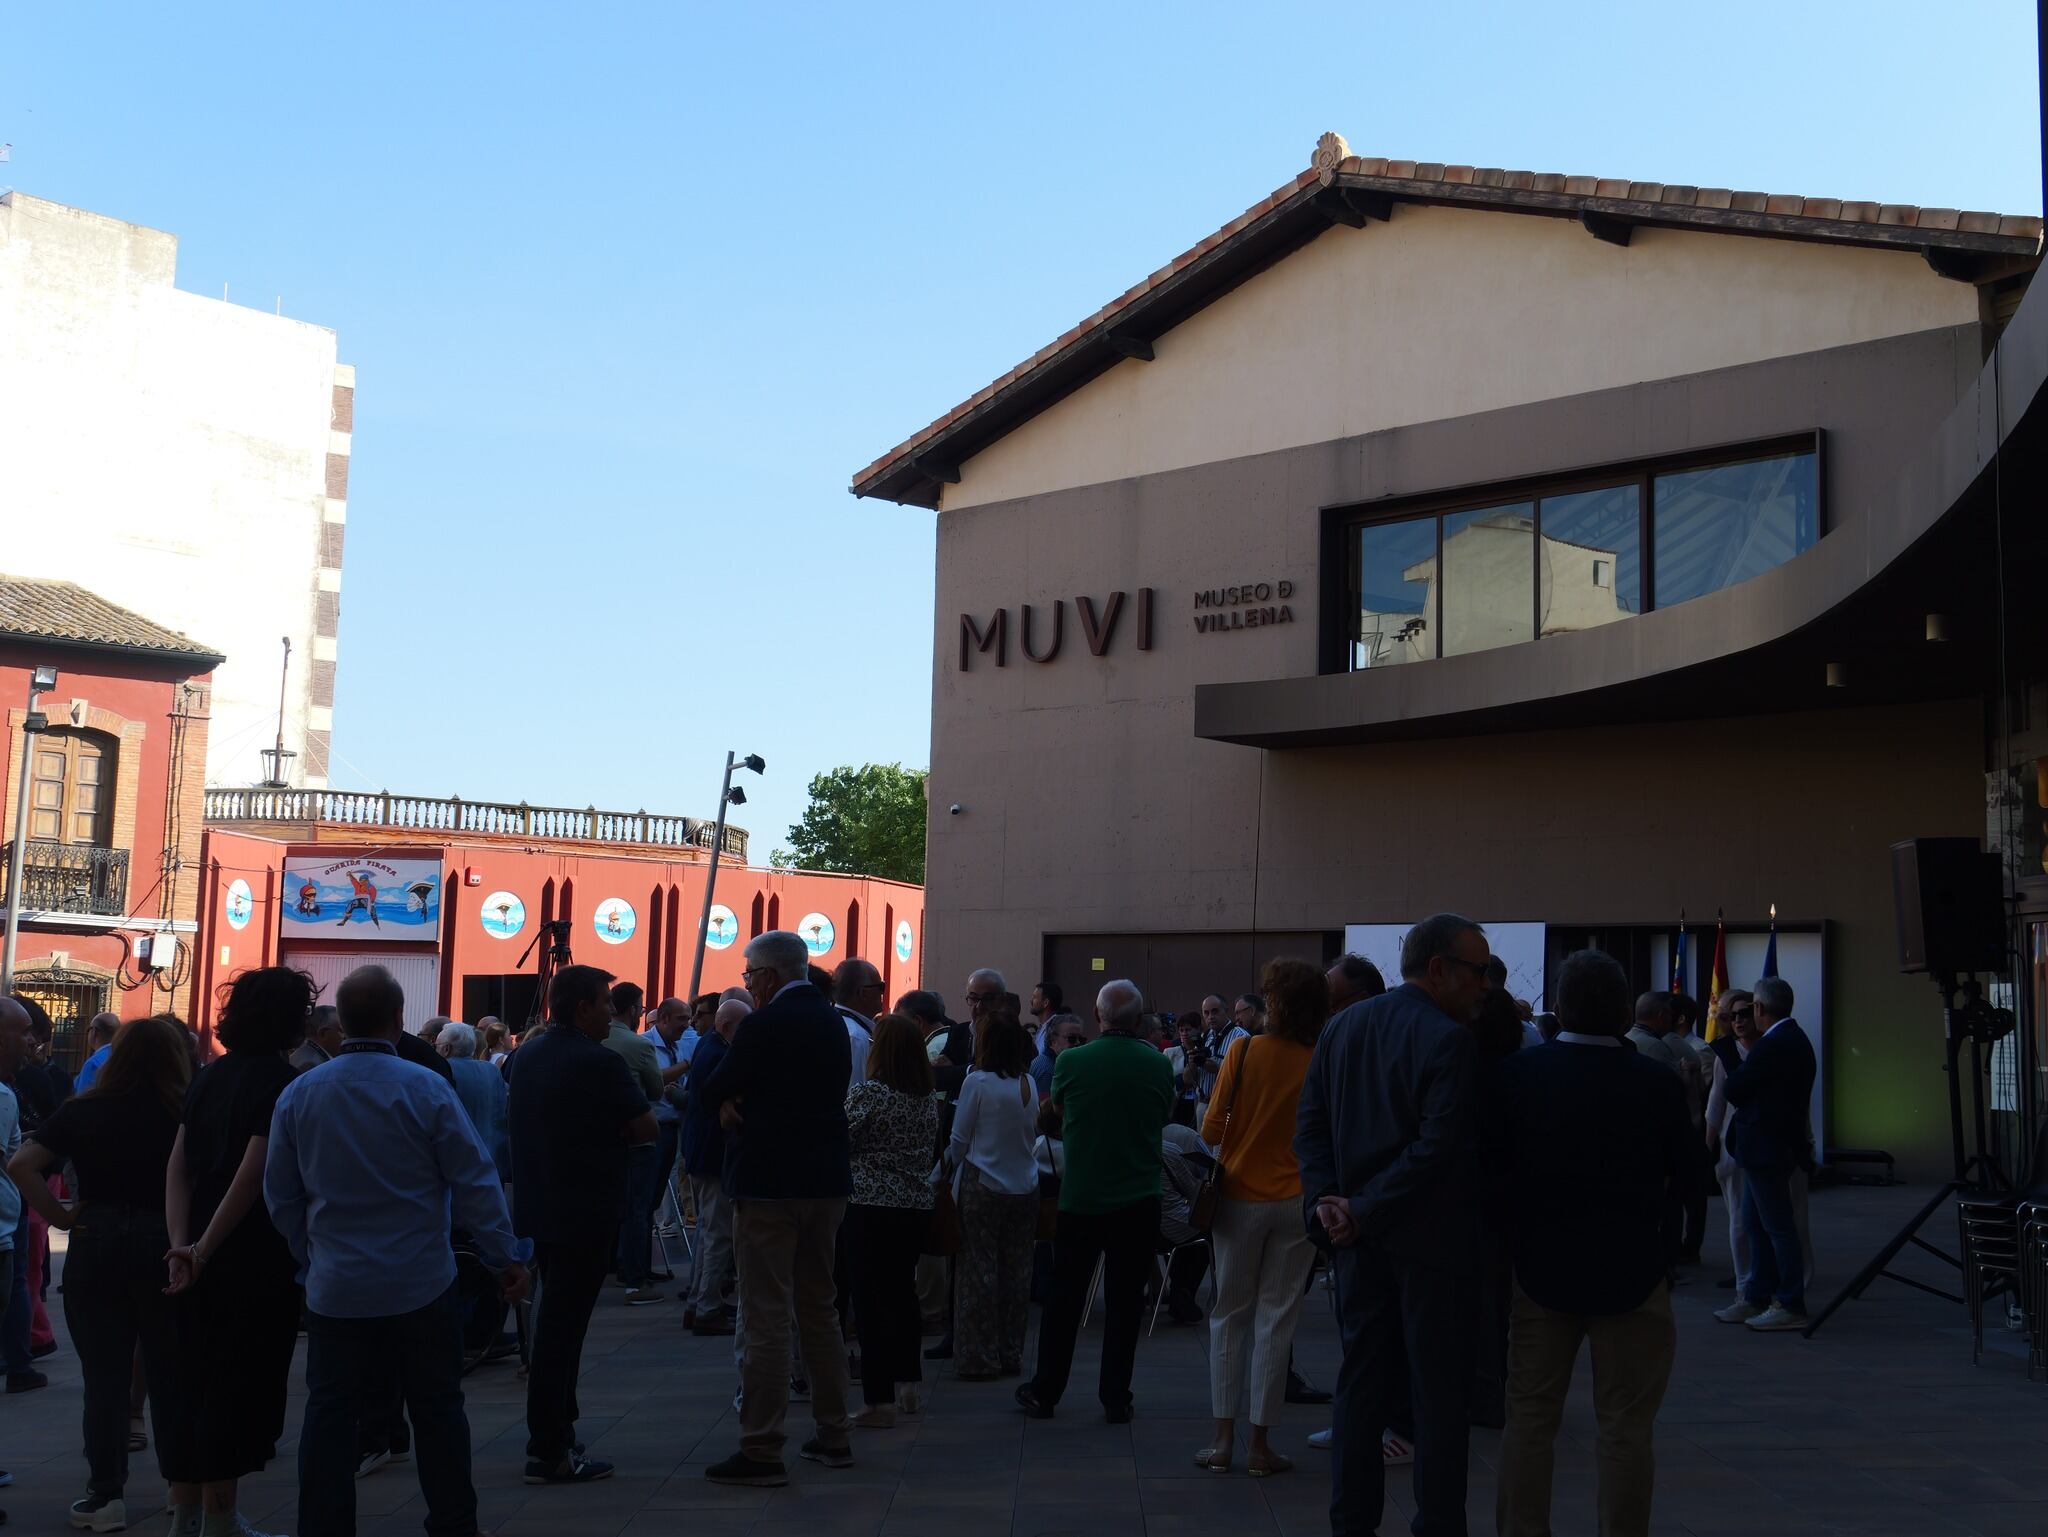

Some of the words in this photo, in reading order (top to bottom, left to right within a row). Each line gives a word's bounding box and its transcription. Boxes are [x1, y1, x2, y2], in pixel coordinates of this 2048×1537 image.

[1194, 583, 1270, 609] MUSEO
[959, 588, 1153, 672] MUVI
[1193, 605, 1293, 633] VILLENA
[366, 860, 397, 876] PIRATA
